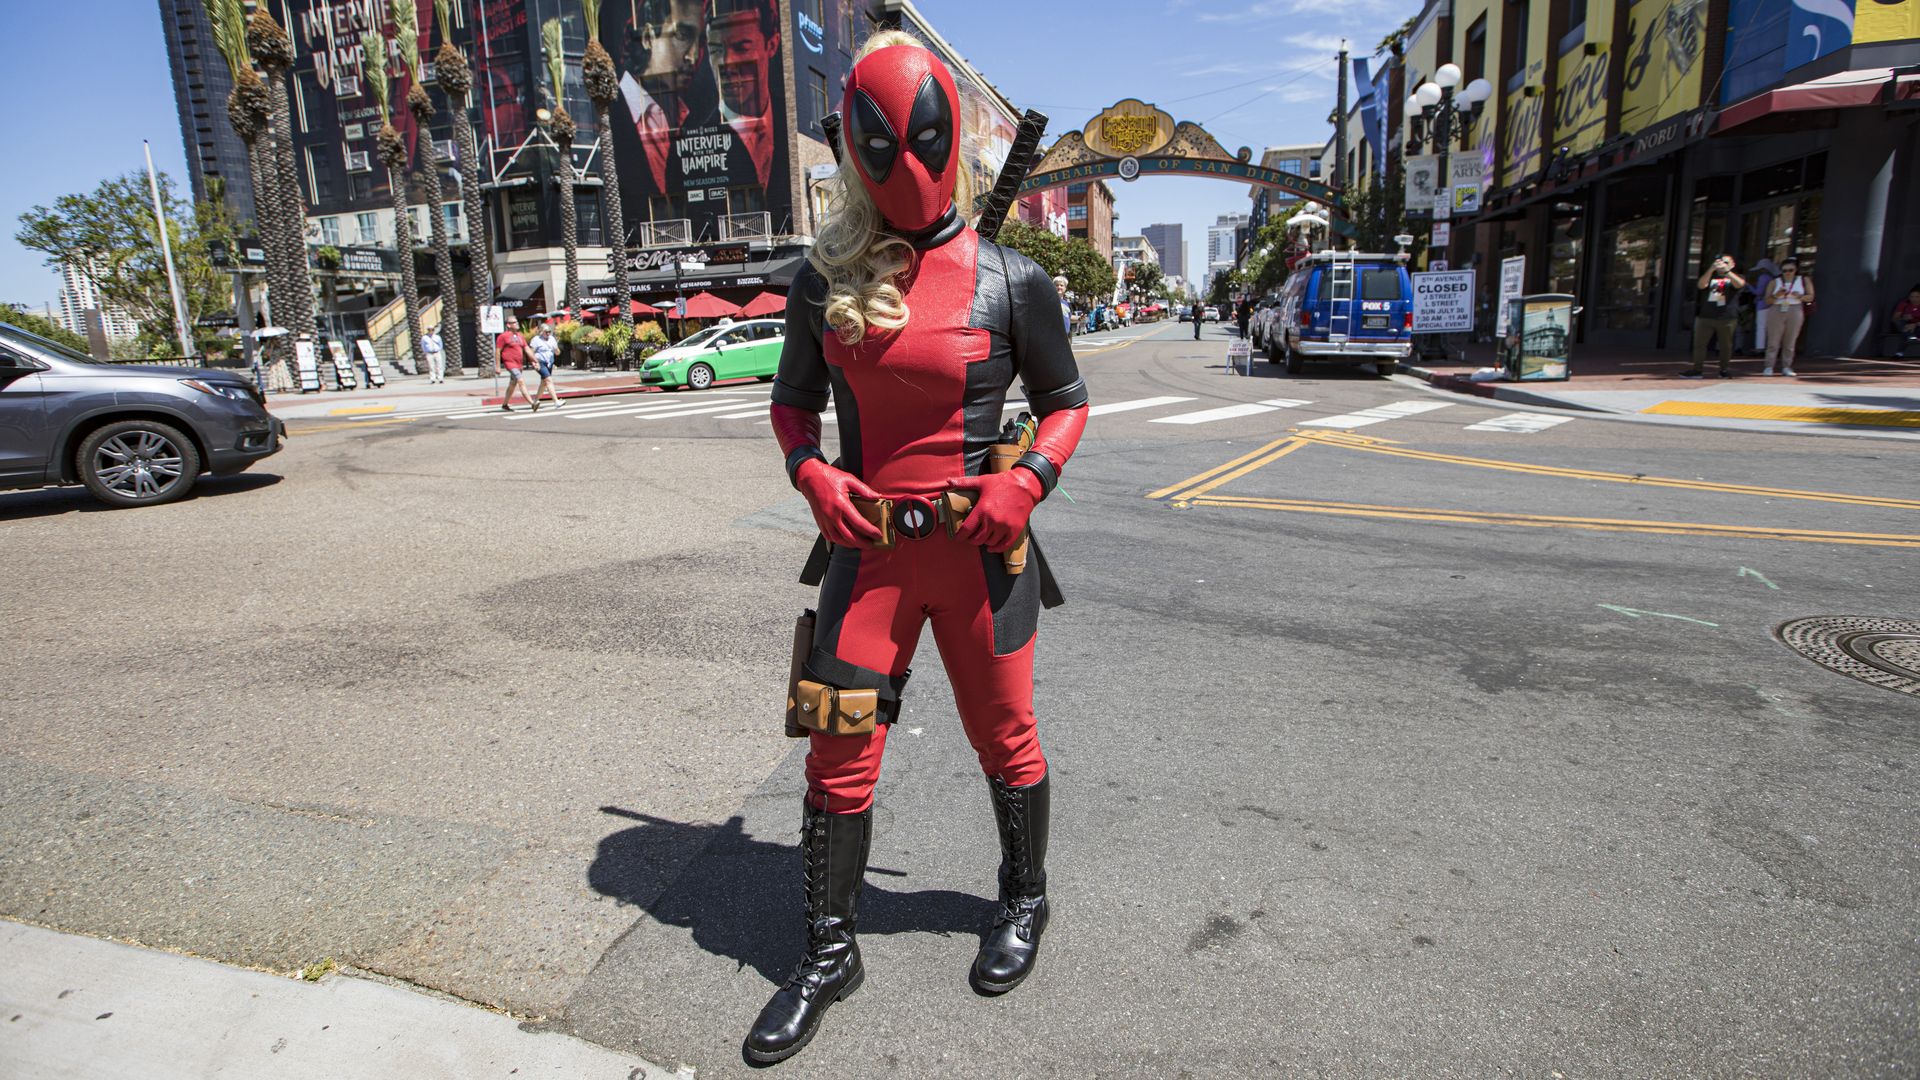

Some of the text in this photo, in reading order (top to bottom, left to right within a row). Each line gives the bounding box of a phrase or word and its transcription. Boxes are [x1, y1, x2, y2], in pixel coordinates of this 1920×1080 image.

[301, 0, 394, 49] INTERVIE
[312, 40, 406, 90] VAMPE
[676, 133, 732, 158] INTERVIEW
[1636, 124, 1678, 152] NOBU
[682, 153, 728, 175] VAMPIRE
[1050, 164, 1104, 182] HEART
[1158, 159, 1181, 168] OF
[1194, 160, 1231, 173] SAN
[1246, 167, 1310, 191] DIEGO
[1453, 168, 1482, 178] ARTS
[696, 178, 716, 186] SEASON
[1418, 284, 1468, 293] CLOSED
[1362, 302, 1390, 310] FOX 5
